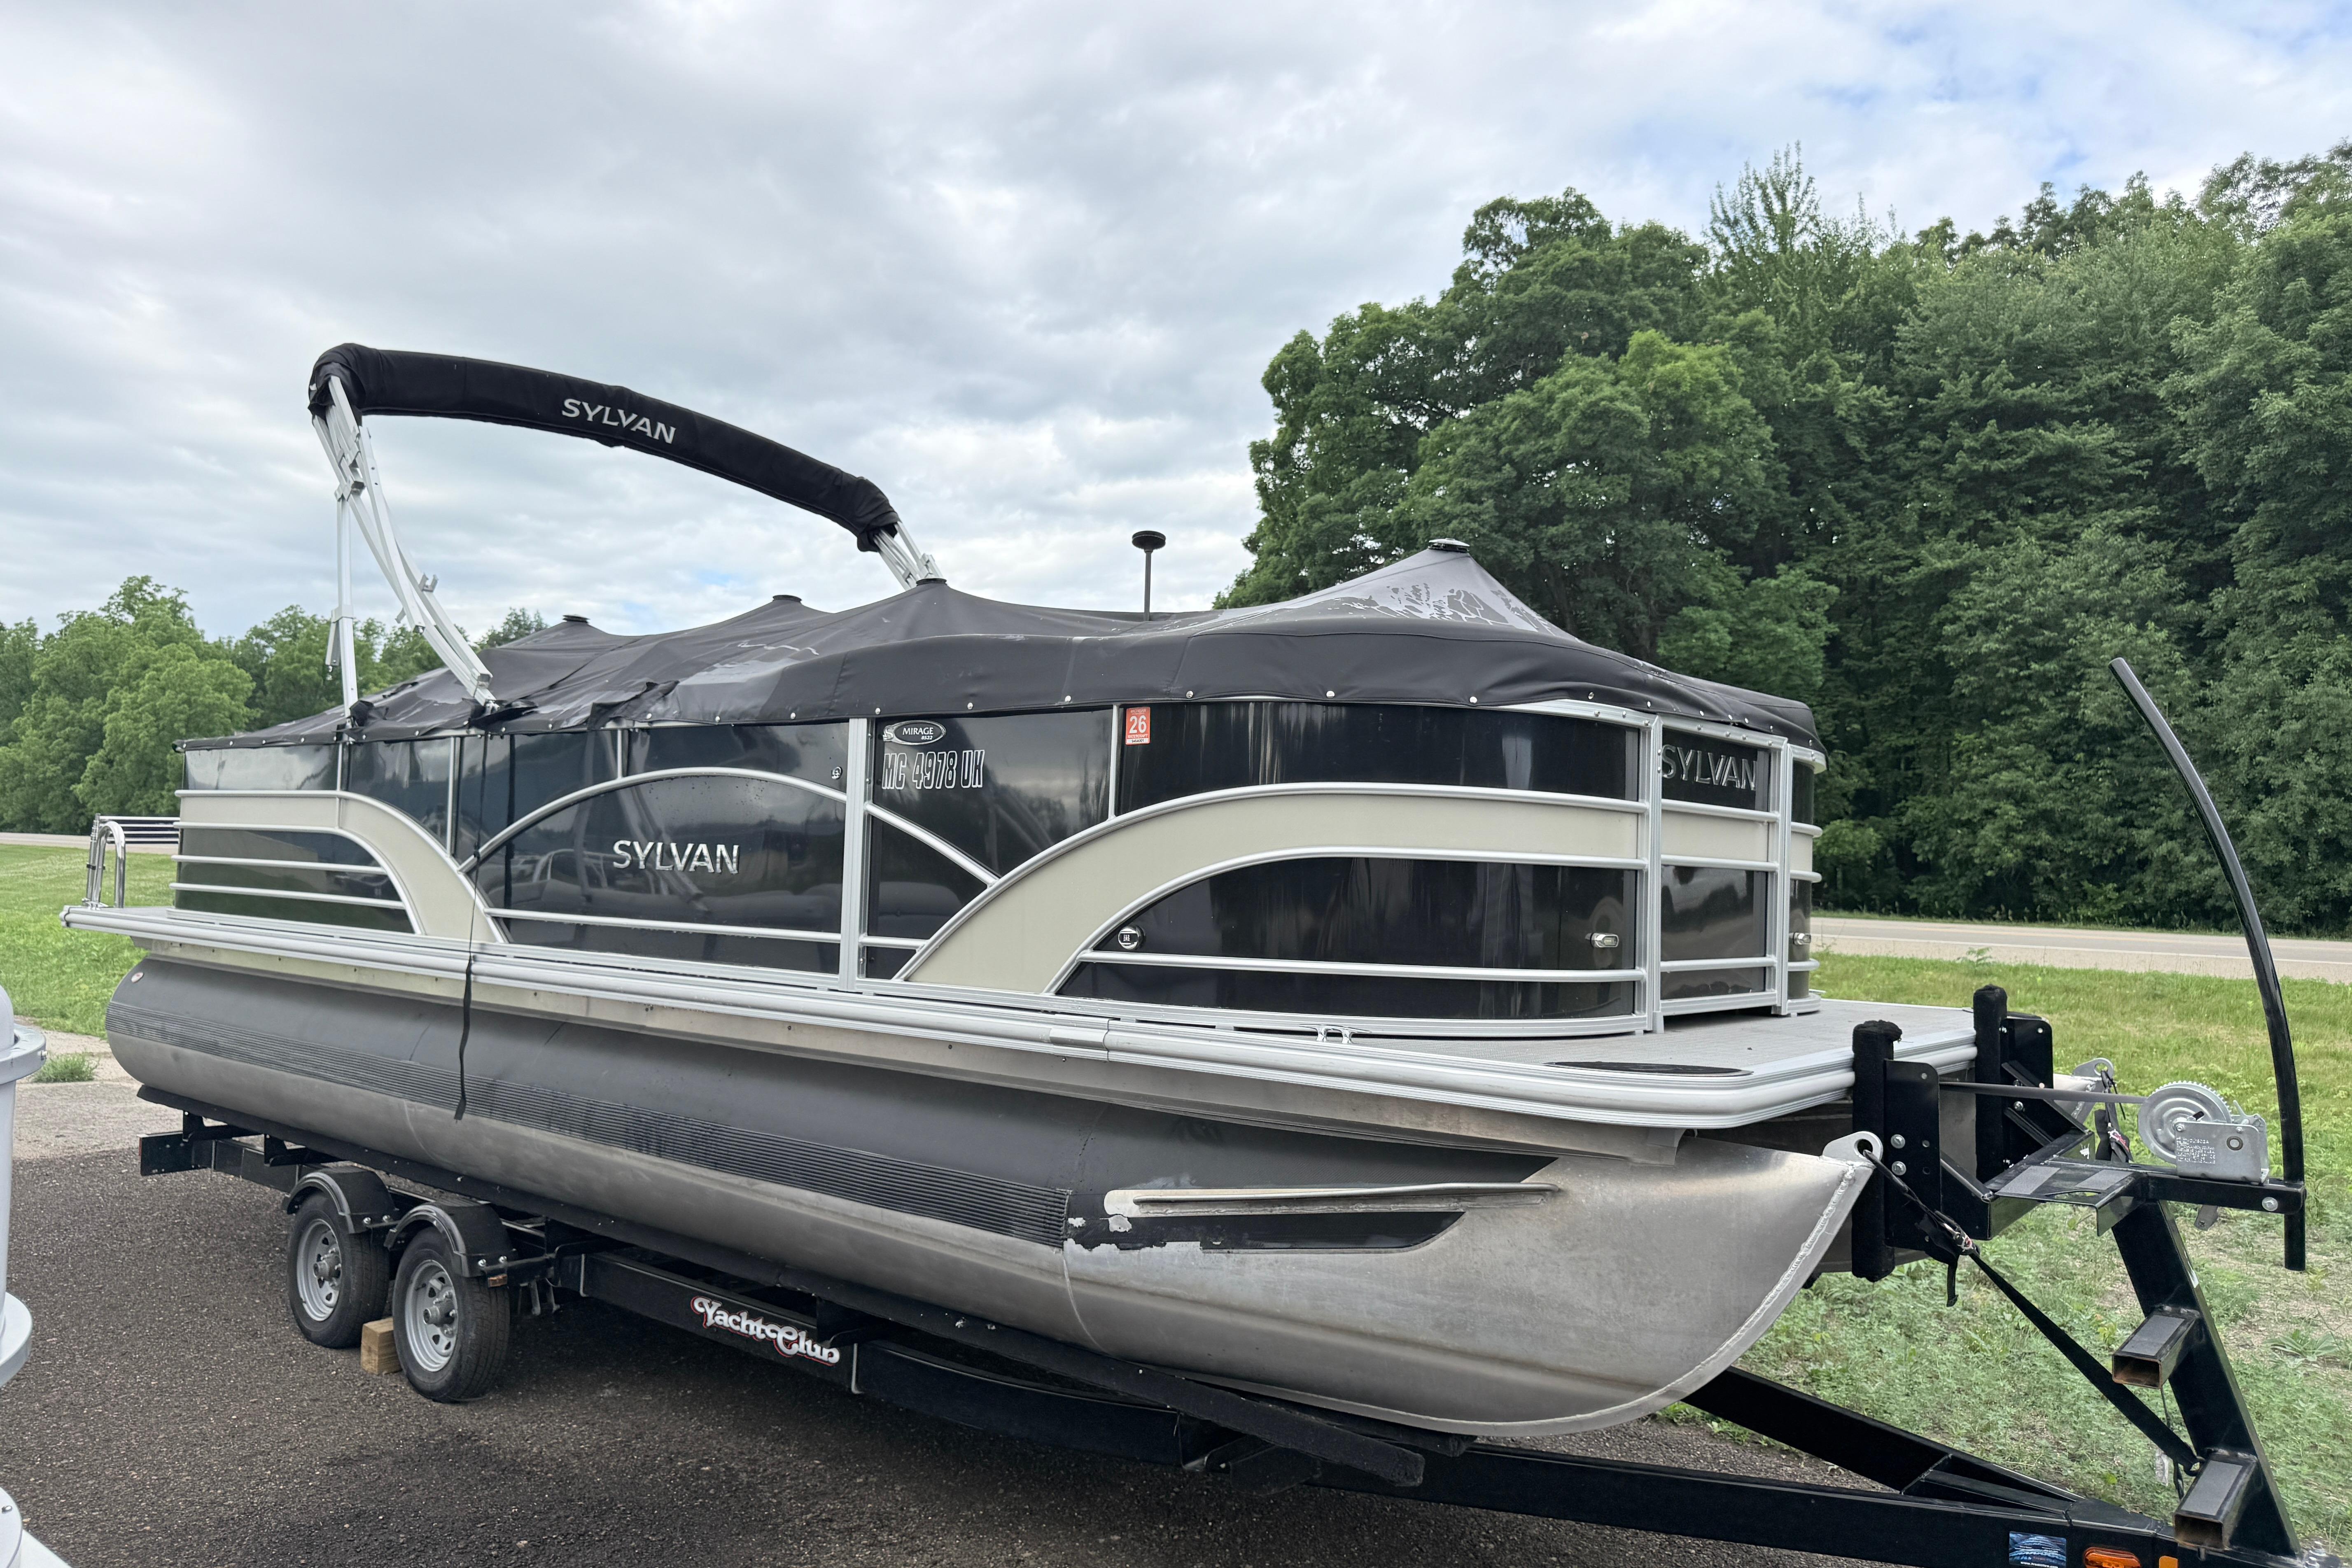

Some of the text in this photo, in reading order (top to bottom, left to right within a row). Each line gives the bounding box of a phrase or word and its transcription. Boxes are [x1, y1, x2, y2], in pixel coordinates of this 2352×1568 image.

[562, 398, 677, 444] SYLVAN
[902, 727, 934, 735] MIRAGE
[1129, 715, 1147, 734] 26
[882, 753, 908, 790] MC
[912, 751, 958, 790] 4978
[1661, 744, 1756, 791] SYLVAN
[613, 840, 740, 874] SYLVAN
